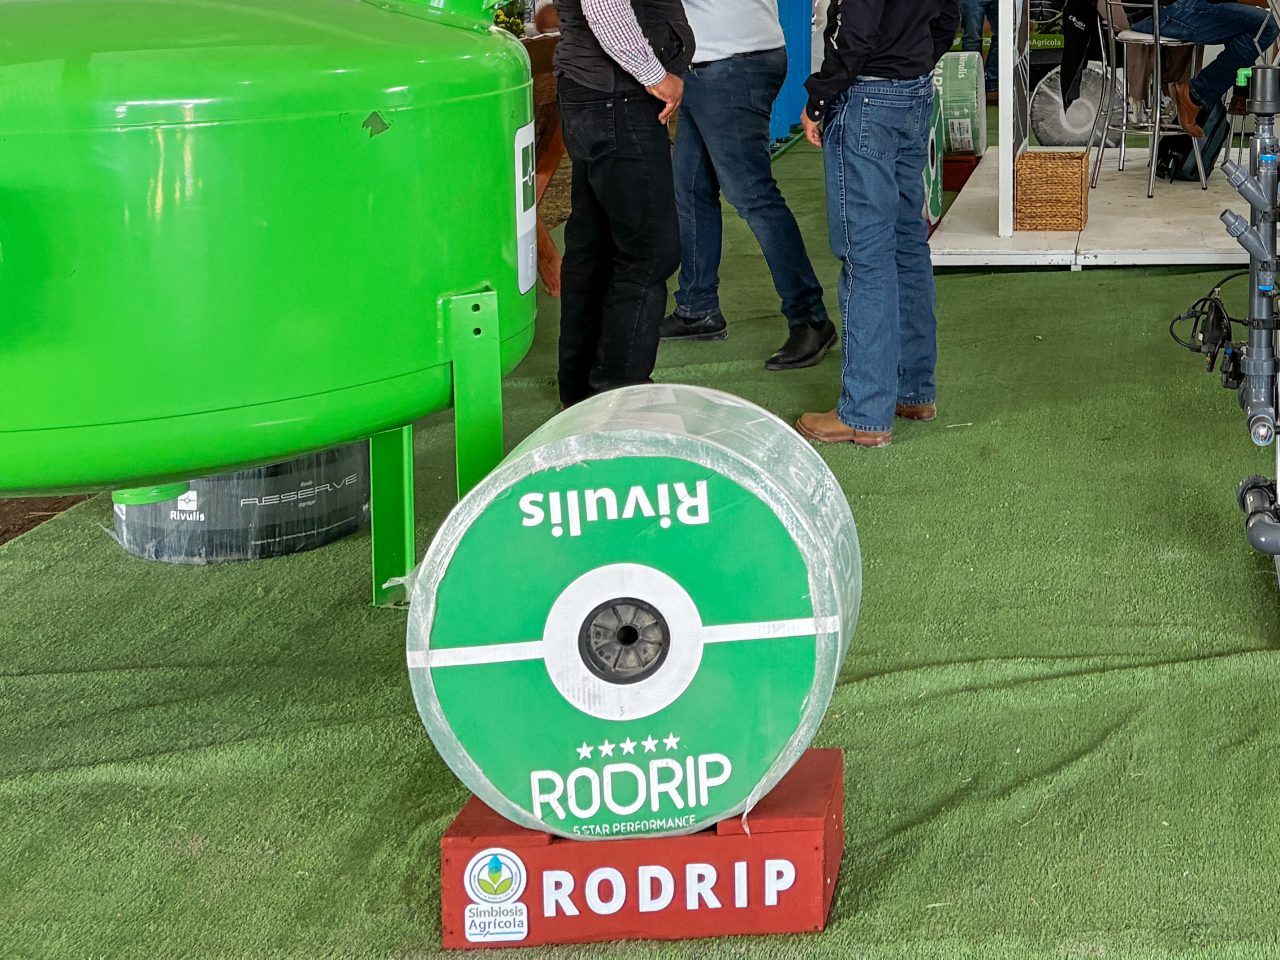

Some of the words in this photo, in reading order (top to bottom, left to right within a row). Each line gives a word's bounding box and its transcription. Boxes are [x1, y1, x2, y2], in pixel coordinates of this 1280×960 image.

[1030, 38, 1061, 48] Agrícola
[241, 473, 358, 507] RESERVE
[170, 511, 205, 521] Rivulis
[518, 480, 709, 537] Rivulis
[530, 753, 732, 820] RODRIP
[582, 824, 610, 835] STAR
[613, 815, 696, 834] PERFORMANCE
[543, 859, 796, 917] RODRIP
[468, 906, 524, 918] Simbiosis
[469, 918, 524, 932] Agrícola
